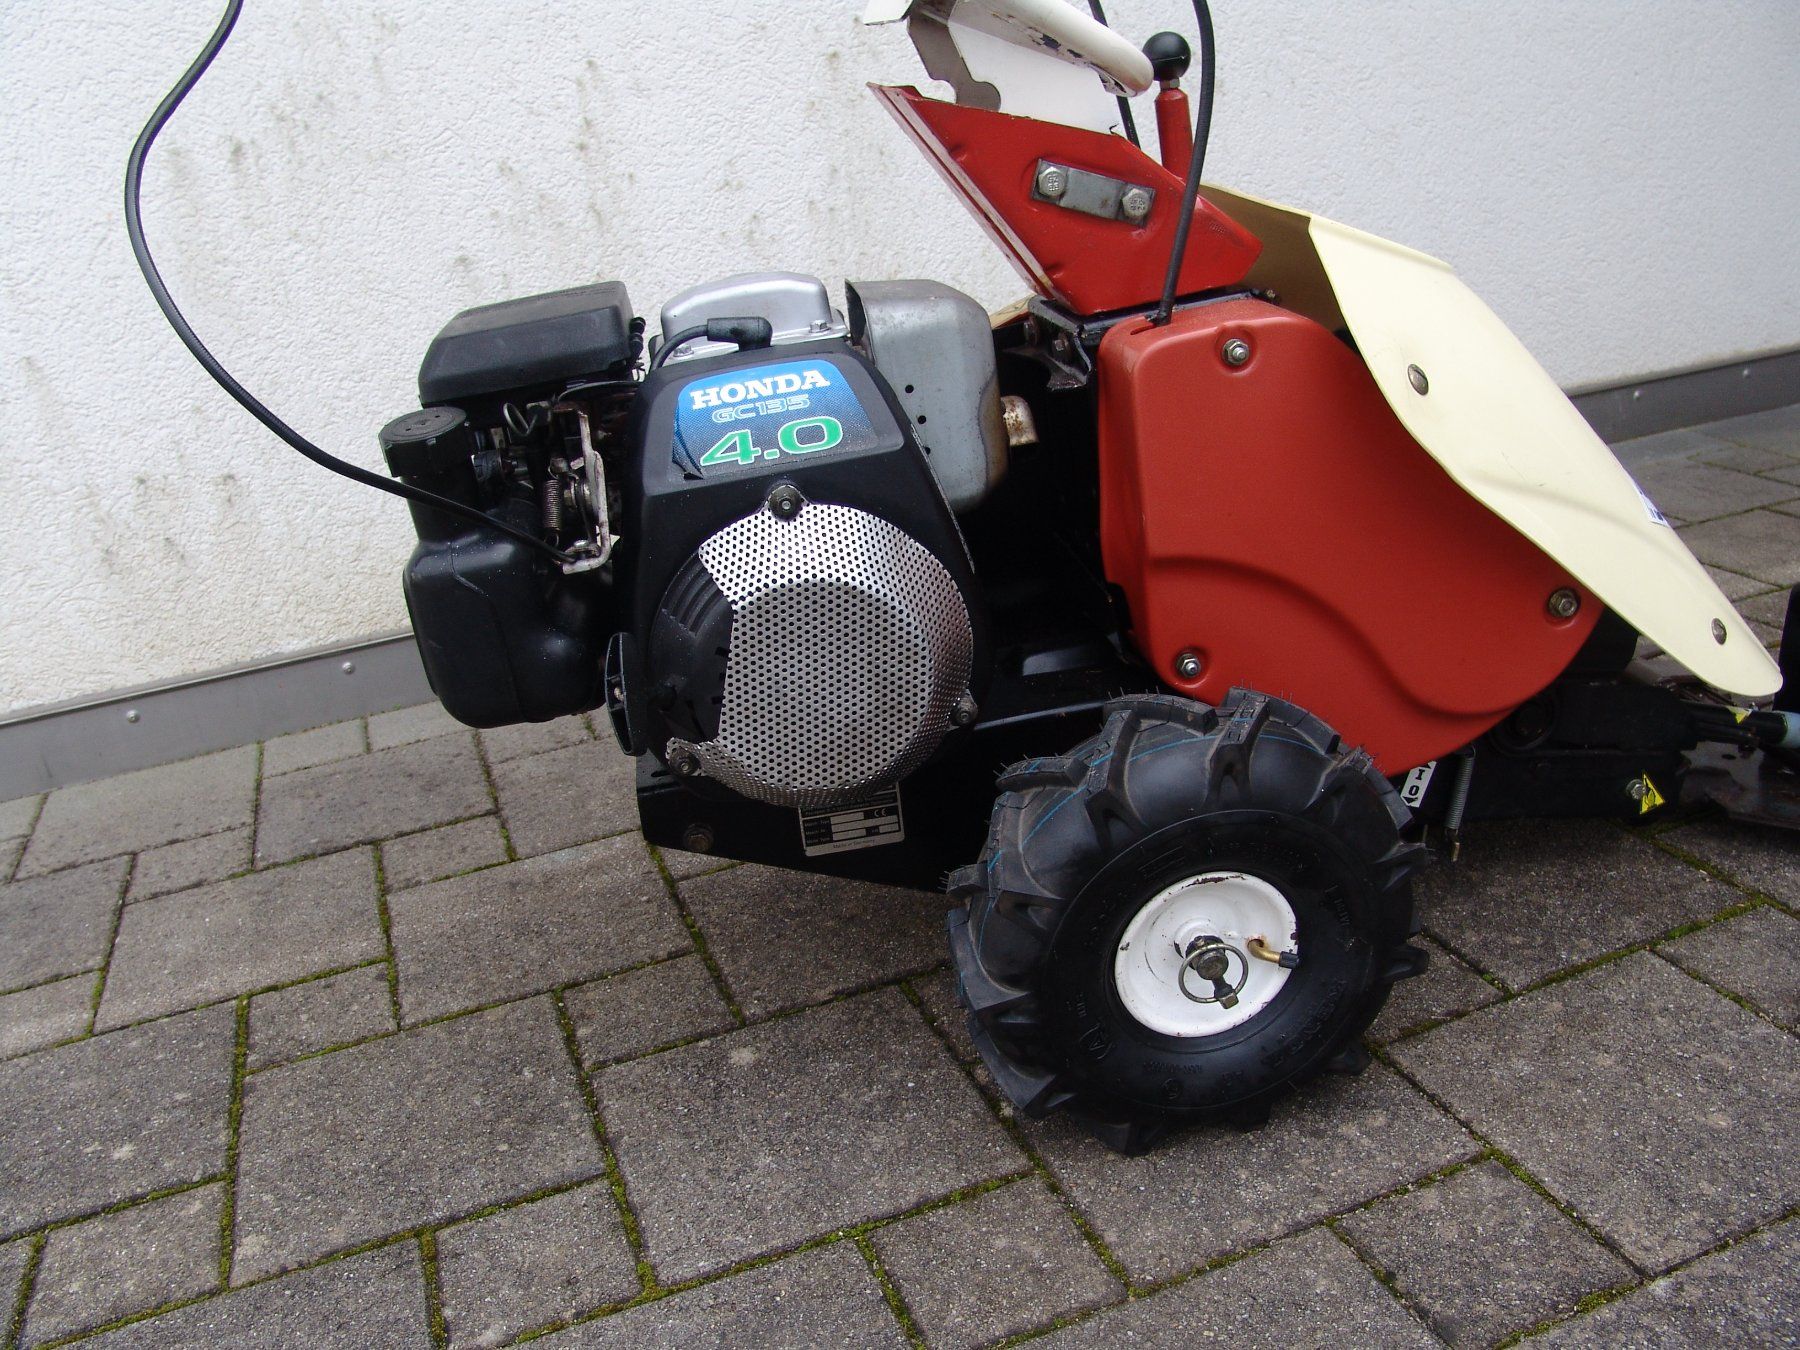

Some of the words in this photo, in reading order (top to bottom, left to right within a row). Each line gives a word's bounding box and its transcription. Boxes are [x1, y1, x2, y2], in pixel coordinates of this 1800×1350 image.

[690, 370, 830, 409] HONDA
[712, 394, 810, 423] GC135
[700, 416, 843, 466] 4.0
